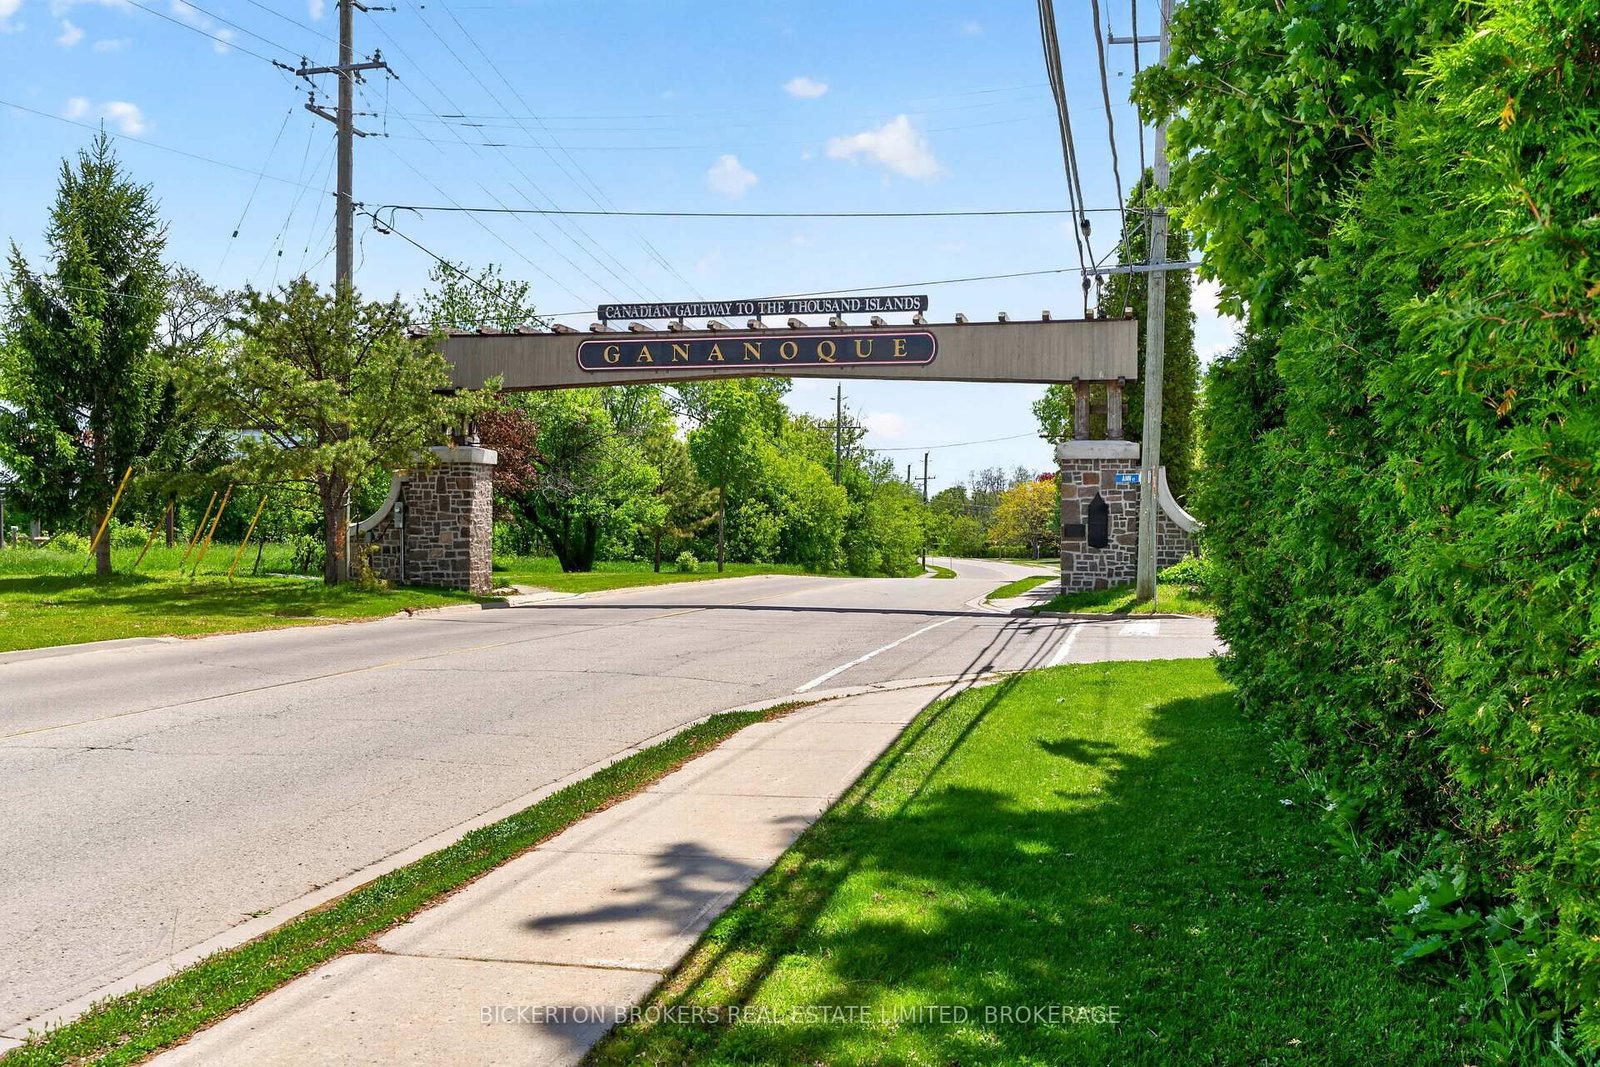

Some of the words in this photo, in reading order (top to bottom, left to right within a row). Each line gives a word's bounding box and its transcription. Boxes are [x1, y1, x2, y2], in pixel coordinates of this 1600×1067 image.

[605, 304, 671, 319] CANADIAN
[675, 302, 732, 317] GATEWAY
[736, 302, 754, 315] TO
[758, 301, 785, 314] THE
[789, 299, 861, 313] THOUSAND
[865, 296, 920, 311] ISLANDS
[603, 338, 908, 364] GANANOQUE
